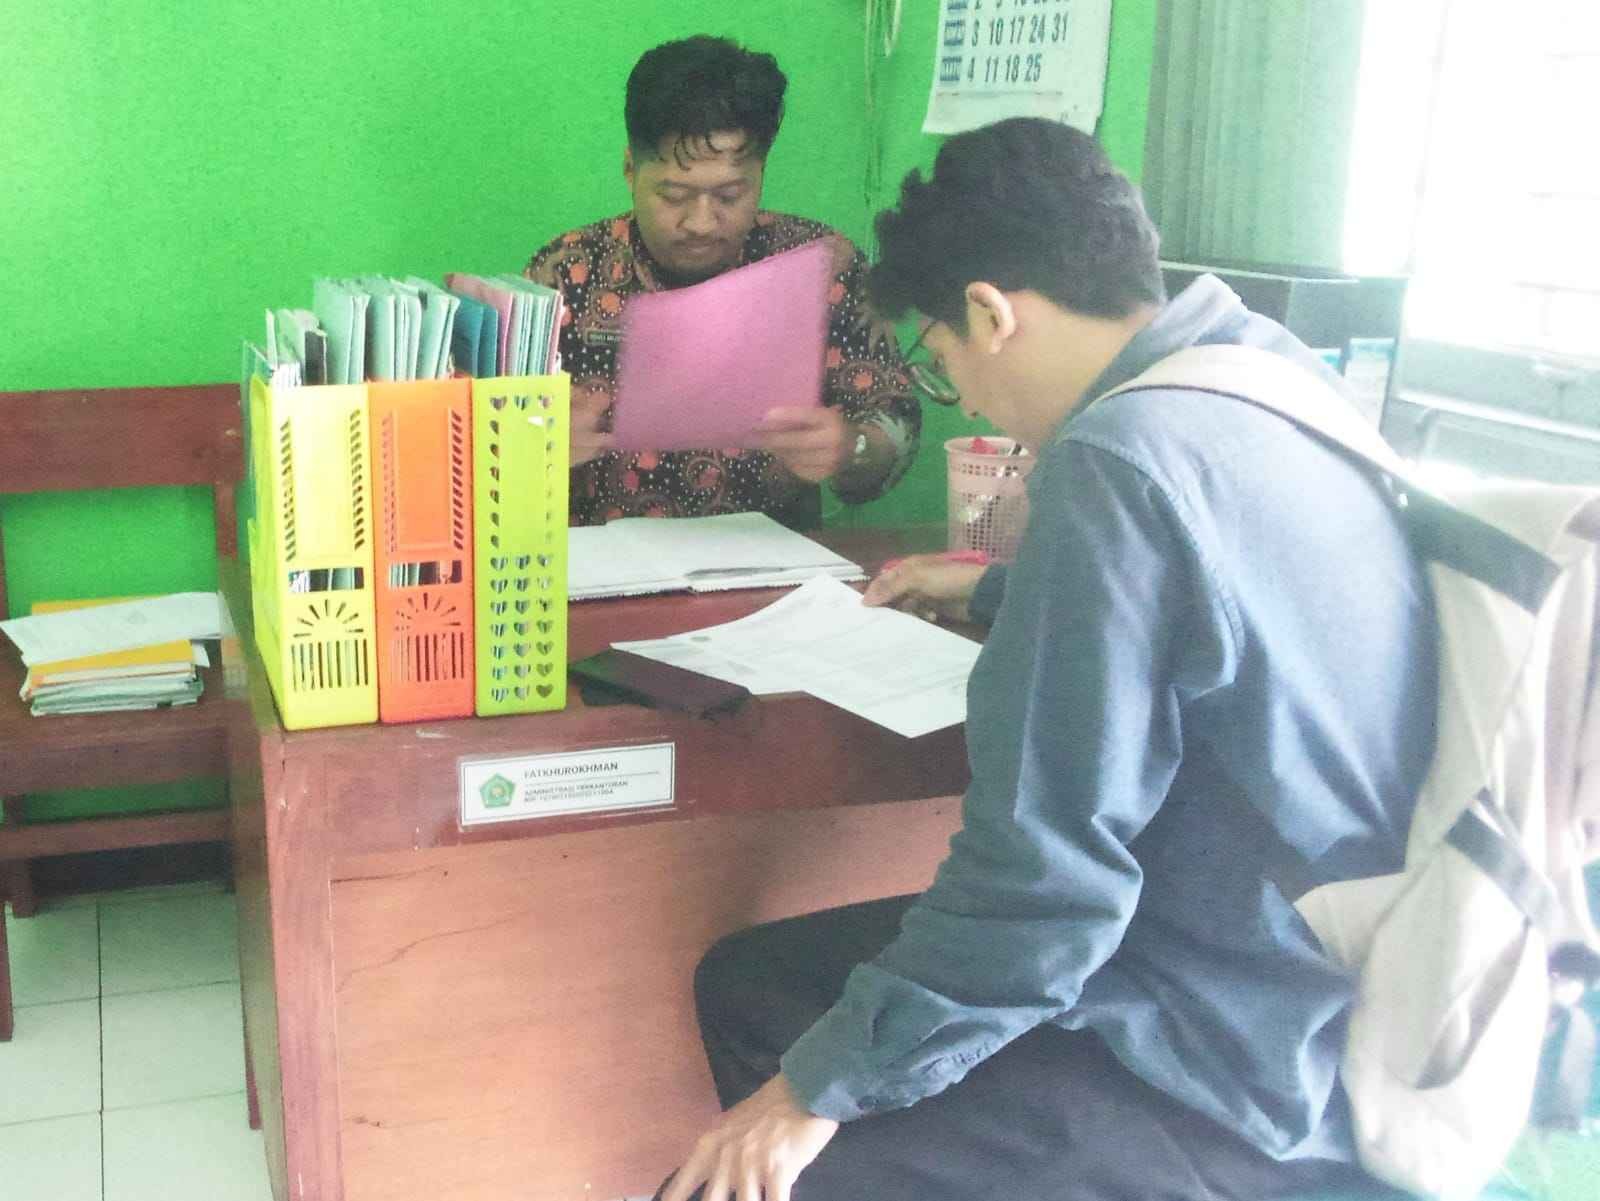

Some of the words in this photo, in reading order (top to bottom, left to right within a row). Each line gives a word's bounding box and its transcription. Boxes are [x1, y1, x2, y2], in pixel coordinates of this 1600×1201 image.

[972, 19, 980, 46] 3
[990, 17, 1004, 45] 10
[1010, 15, 1025, 44] 17
[1028, 13, 1046, 43] 24
[1051, 11, 1069, 42] 31
[967, 56, 976, 81] 4
[984, 55, 999, 82] 11
[1005, 54, 1020, 82] 18
[1024, 53, 1042, 82] 25
[524, 761, 619, 778] FATKHUROKHMAN
